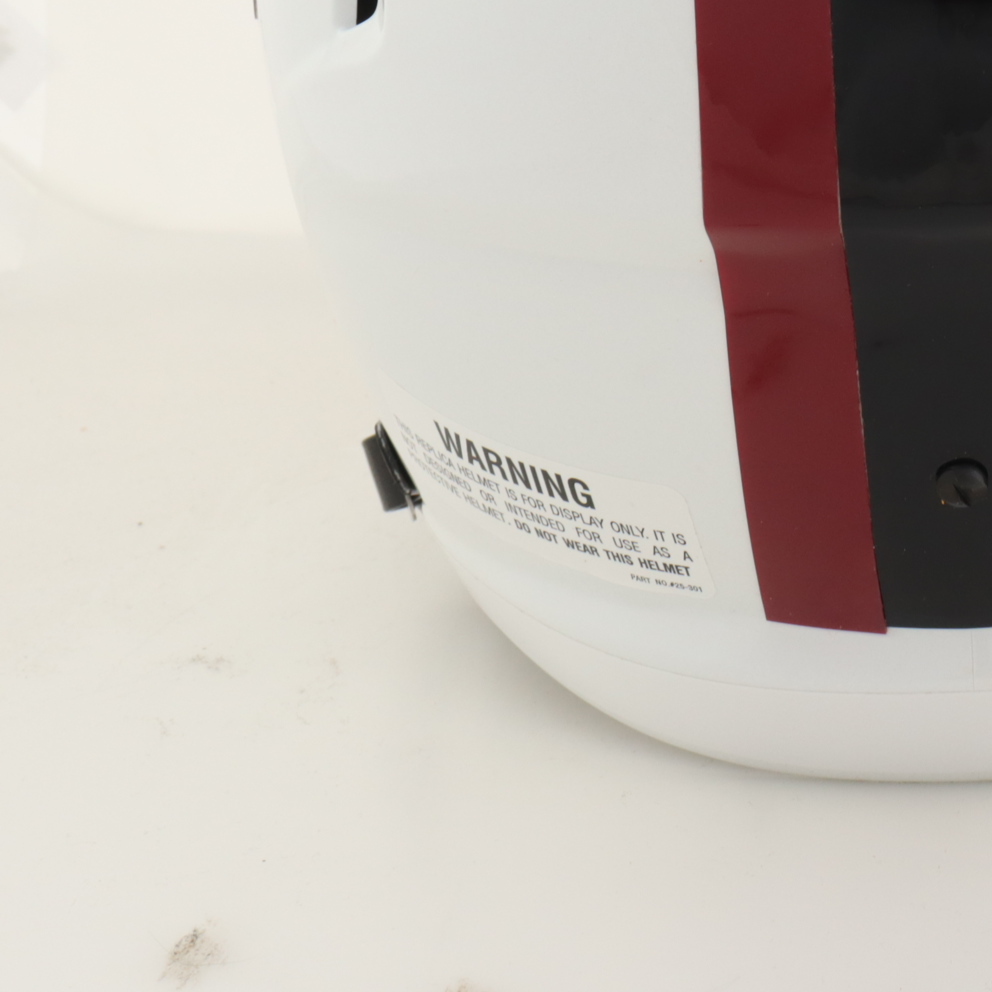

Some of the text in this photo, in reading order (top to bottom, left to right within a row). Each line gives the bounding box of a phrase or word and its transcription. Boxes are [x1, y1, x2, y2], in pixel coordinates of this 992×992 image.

[433, 419, 596, 510] WARNING
[457, 462, 501, 494] HELMET
[505, 487, 518, 502] IS
[521, 493, 547, 513] FOR
[549, 503, 604, 529] DISPLAY
[610, 521, 649, 539] ONLY.
[653, 529, 665, 542] IT
[671, 532, 687, 546] IS
[479, 489, 498, 506] OR
[504, 501, 566, 533] INTENDED
[575, 527, 603, 545] FOR
[612, 536, 641, 553] USE
[653, 545, 671, 559] AS
[683, 550, 694, 563] A
[514, 519, 532, 535] DO
[534, 528, 559, 545] NOT
[562, 536, 601, 558] WEAR
[603, 549, 634, 566] THIS
[637, 557, 691, 577] HELMET
[630, 573, 651, 585] PART
